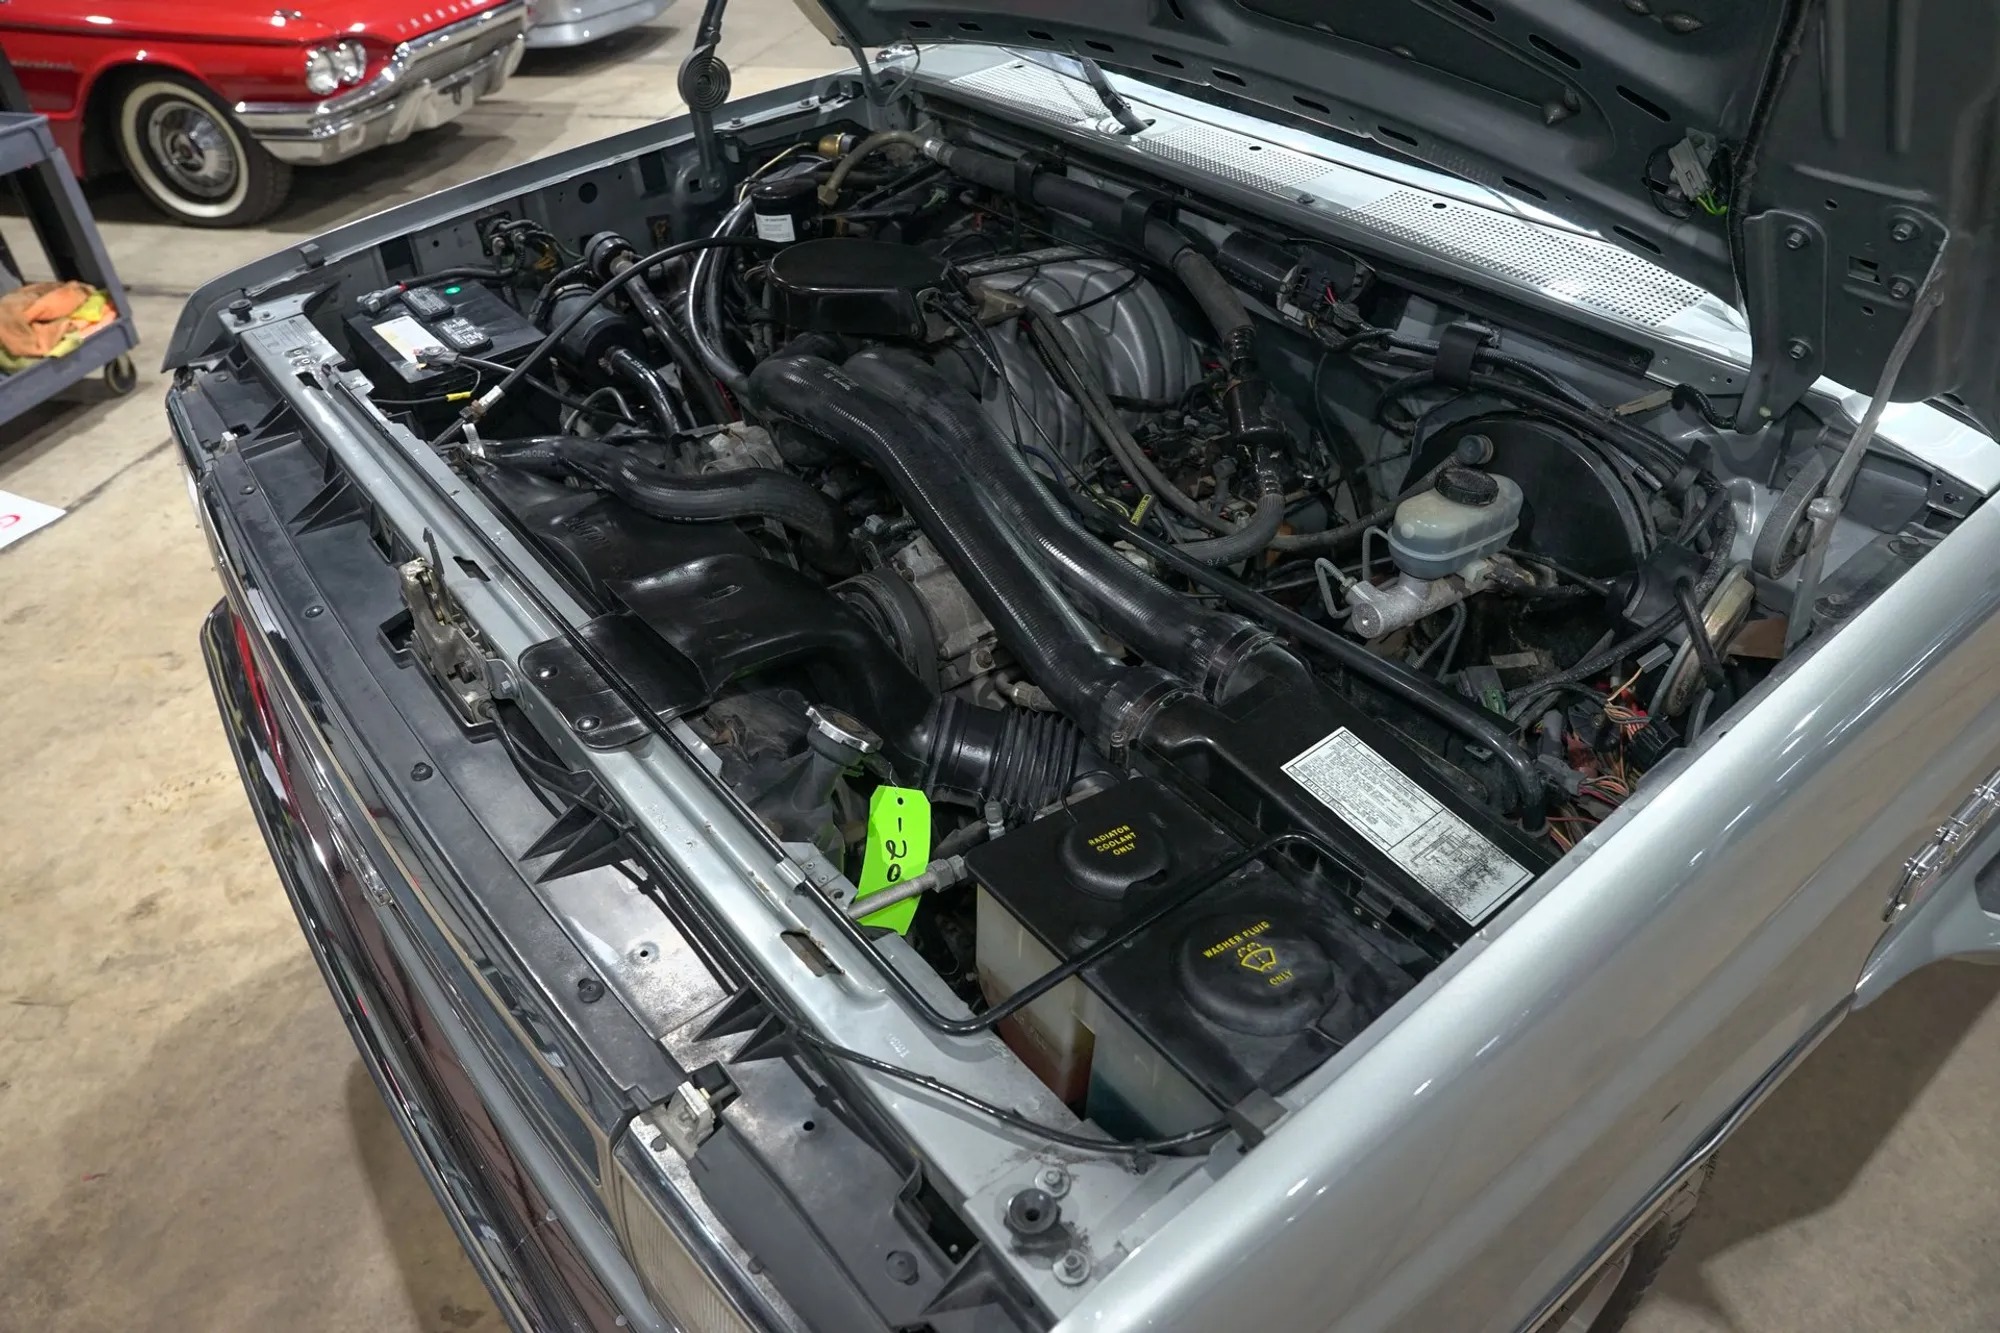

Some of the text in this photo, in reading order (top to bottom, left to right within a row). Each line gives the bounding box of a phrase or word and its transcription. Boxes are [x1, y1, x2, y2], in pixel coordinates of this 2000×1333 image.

[1088, 825, 1131, 846] RADIATOR
[1096, 832, 1137, 852] COOLANT
[1113, 842, 1136, 857] ONLY
[1242, 920, 1270, 938] FLUID
[1203, 935, 1243, 959] WASHER
[1269, 969, 1294, 986] ONLY
